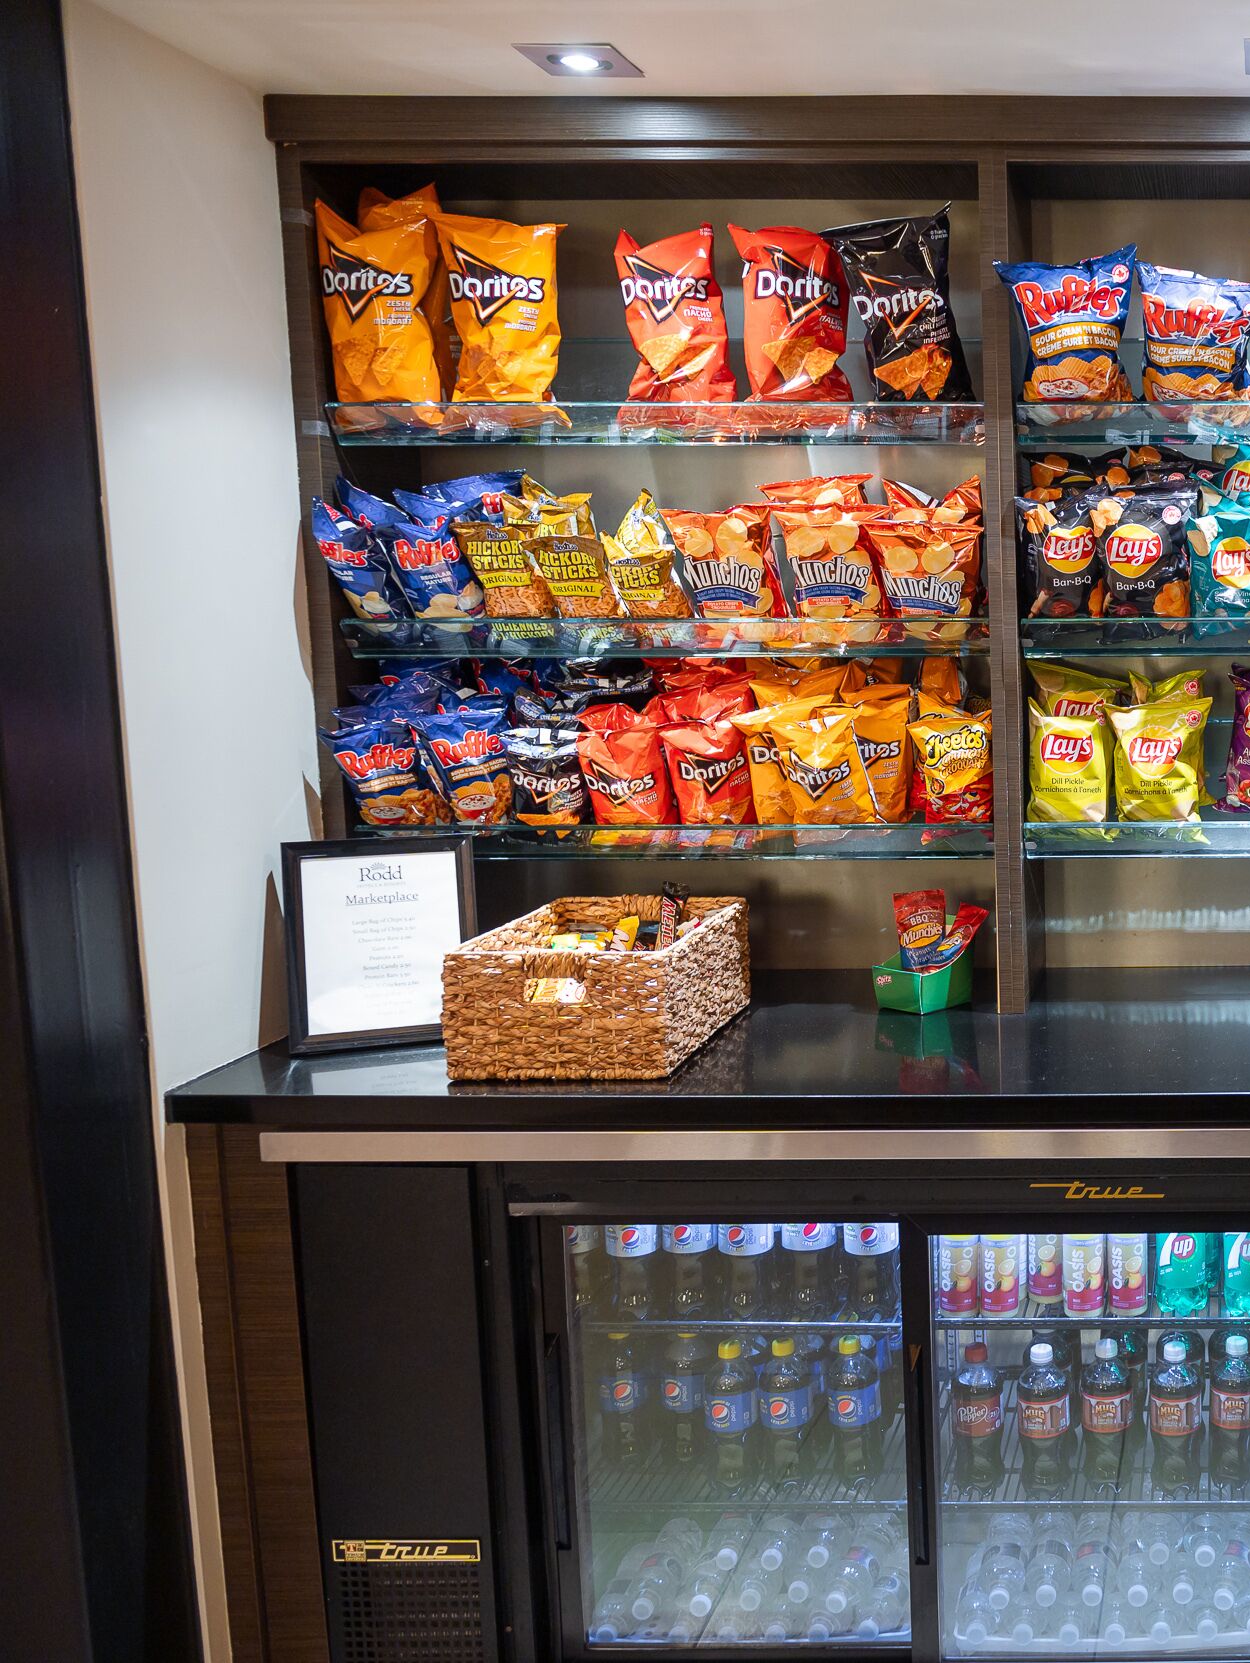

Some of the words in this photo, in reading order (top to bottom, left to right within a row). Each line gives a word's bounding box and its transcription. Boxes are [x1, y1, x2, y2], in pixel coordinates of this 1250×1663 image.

[322, 267, 413, 296] Doritos
[449, 272, 545, 301] Doritos
[622, 276, 708, 307] Doritos
[757, 271, 839, 305] Doritos
[853, 289, 945, 321] Doritos
[1014, 274, 1126, 329] Ruffles
[1143, 293, 1250, 344] Ruffles
[1035, 330, 1056, 346] SOUR
[1056, 326, 1082, 340] CREAM
[1091, 326, 1116, 339] BACON
[1037, 341, 1062, 357] CRÈME
[1063, 338, 1083, 350] SURE
[1084, 337, 1094, 346] ET
[1094, 337, 1118, 350] BACON
[1203, 355, 1230, 369] BACON
[394, 537, 460, 571] Ruffles
[1047, 534, 1095, 561] Lay's
[1109, 537, 1162, 565] Lay's
[472, 555, 525, 570] STICKS
[542, 564, 599, 580] STICKS
[482, 575, 525, 585] ORIGINAL
[553, 584, 596, 593] ORIGINAL
[881, 567, 960, 606] Munchos
[859, 741, 900, 758] ritos
[926, 729, 984, 767] Cheetos
[942, 750, 988, 767] CRUNCHY
[1045, 734, 1091, 762] Lay's
[1132, 736, 1180, 765] Lay's
[335, 744, 416, 779] Ruffles
[681, 752, 745, 781] Doritos
[940, 759, 987, 779] CROQUANT
[511, 768, 581, 794] Doritos
[788, 762, 850, 785] Doritos
[1051, 777, 1063, 785] Dill
[1065, 777, 1085, 785] Pickle
[1153, 779, 1172, 787] Pickle
[584, 774, 655, 796] Doritos
[1035, 785, 1072, 793] Cornichons
[1125, 787, 1161, 796] Cornichons
[360, 865, 403, 881] Rodd
[346, 891, 419, 905] Marketplace
[910, 914, 928, 926] BBQ
[902, 924, 942, 946] Munchies
[1030, 1181, 1164, 1199] true
[942, 1248, 951, 1292] OASIS
[984, 1249, 995, 1293] OASIS
[1072, 1249, 1084, 1293] OASIS
[1112, 1246, 1123, 1290] OASIS
[959, 1408, 986, 1422] Pepper
[967, 1405, 978, 1415] Dr
[1023, 1408, 1045, 1420] MUG
[1095, 1404, 1116, 1414] MUG
[1160, 1405, 1181, 1416] MUG
[1224, 1400, 1245, 1410] MUG
